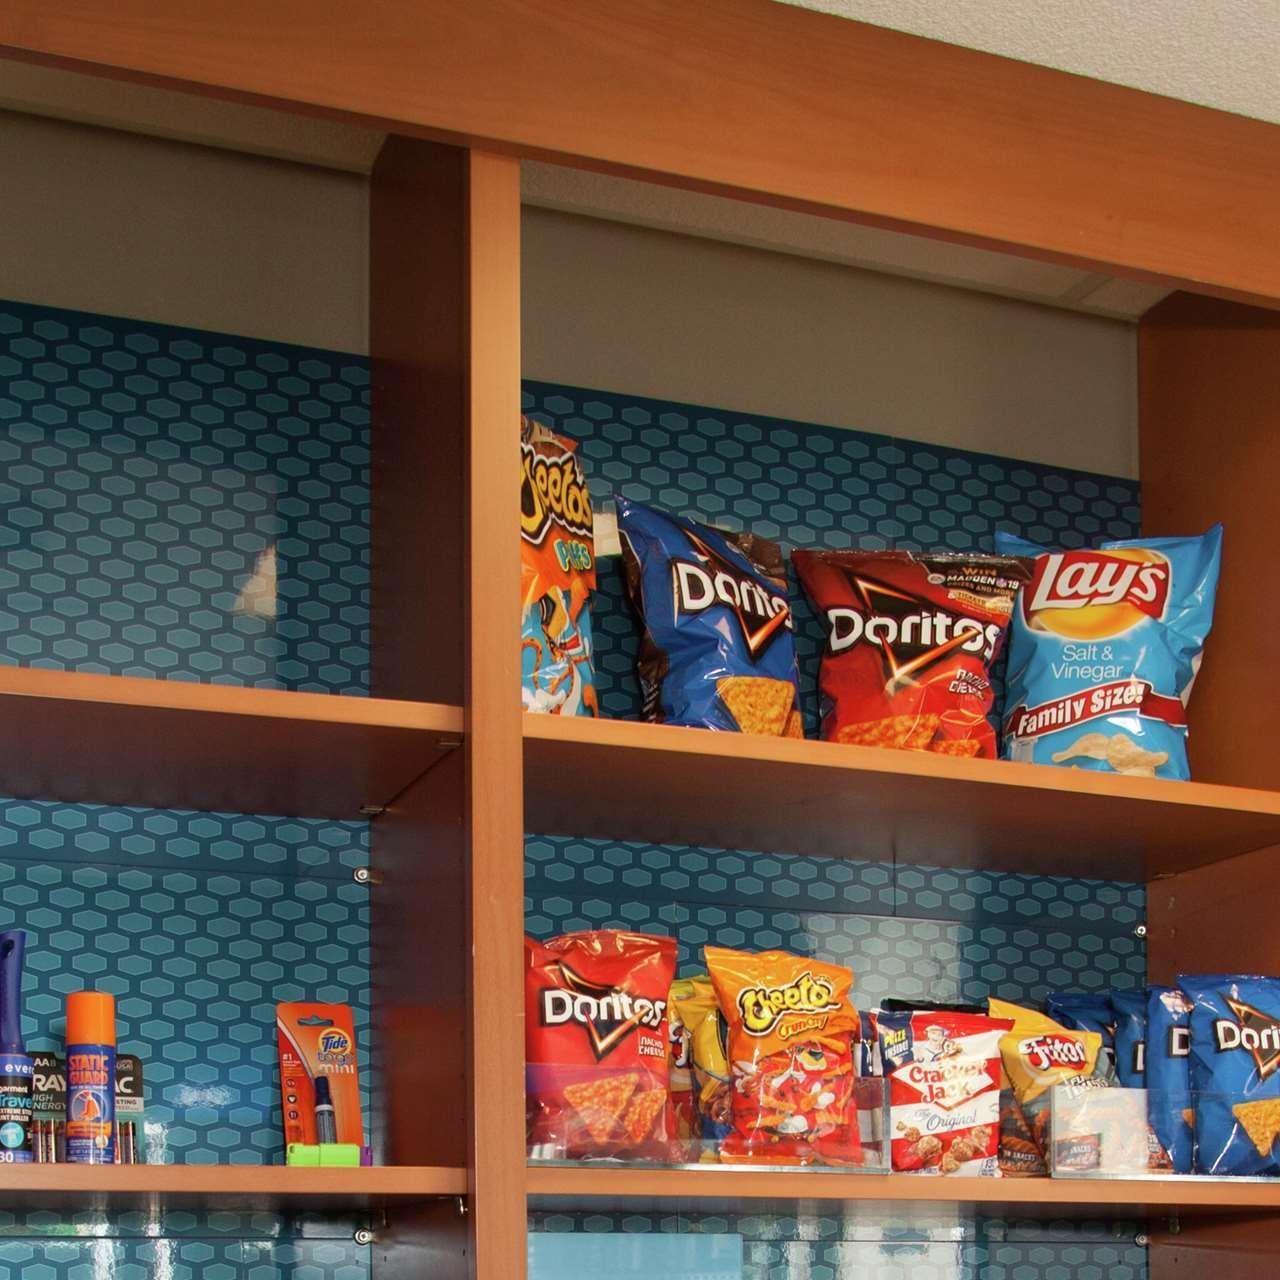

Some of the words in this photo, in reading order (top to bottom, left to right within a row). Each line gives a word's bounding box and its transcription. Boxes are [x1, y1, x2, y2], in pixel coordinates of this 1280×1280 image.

[1030, 553, 1167, 611] Lay's
[679, 562, 793, 630] Doritos
[827, 608, 1001, 660] Doritos
[1062, 644, 1098, 662] Salt
[1101, 645, 1114, 662] &
[1051, 661, 1124, 681] Vinegar
[1017, 693, 1084, 738] Family
[1091, 682, 1145, 715] Size!
[544, 988, 667, 1027] Doritos
[321, 1035, 348, 1052] Tide
[640, 1036, 664, 1048] NACHO
[884, 1029, 906, 1045] PRIZE
[69, 1055, 109, 1072] STATIC
[320, 1063, 355, 1075] mini
[69, 1070, 109, 1085] GUARD
[927, 1110, 977, 1132] Original
